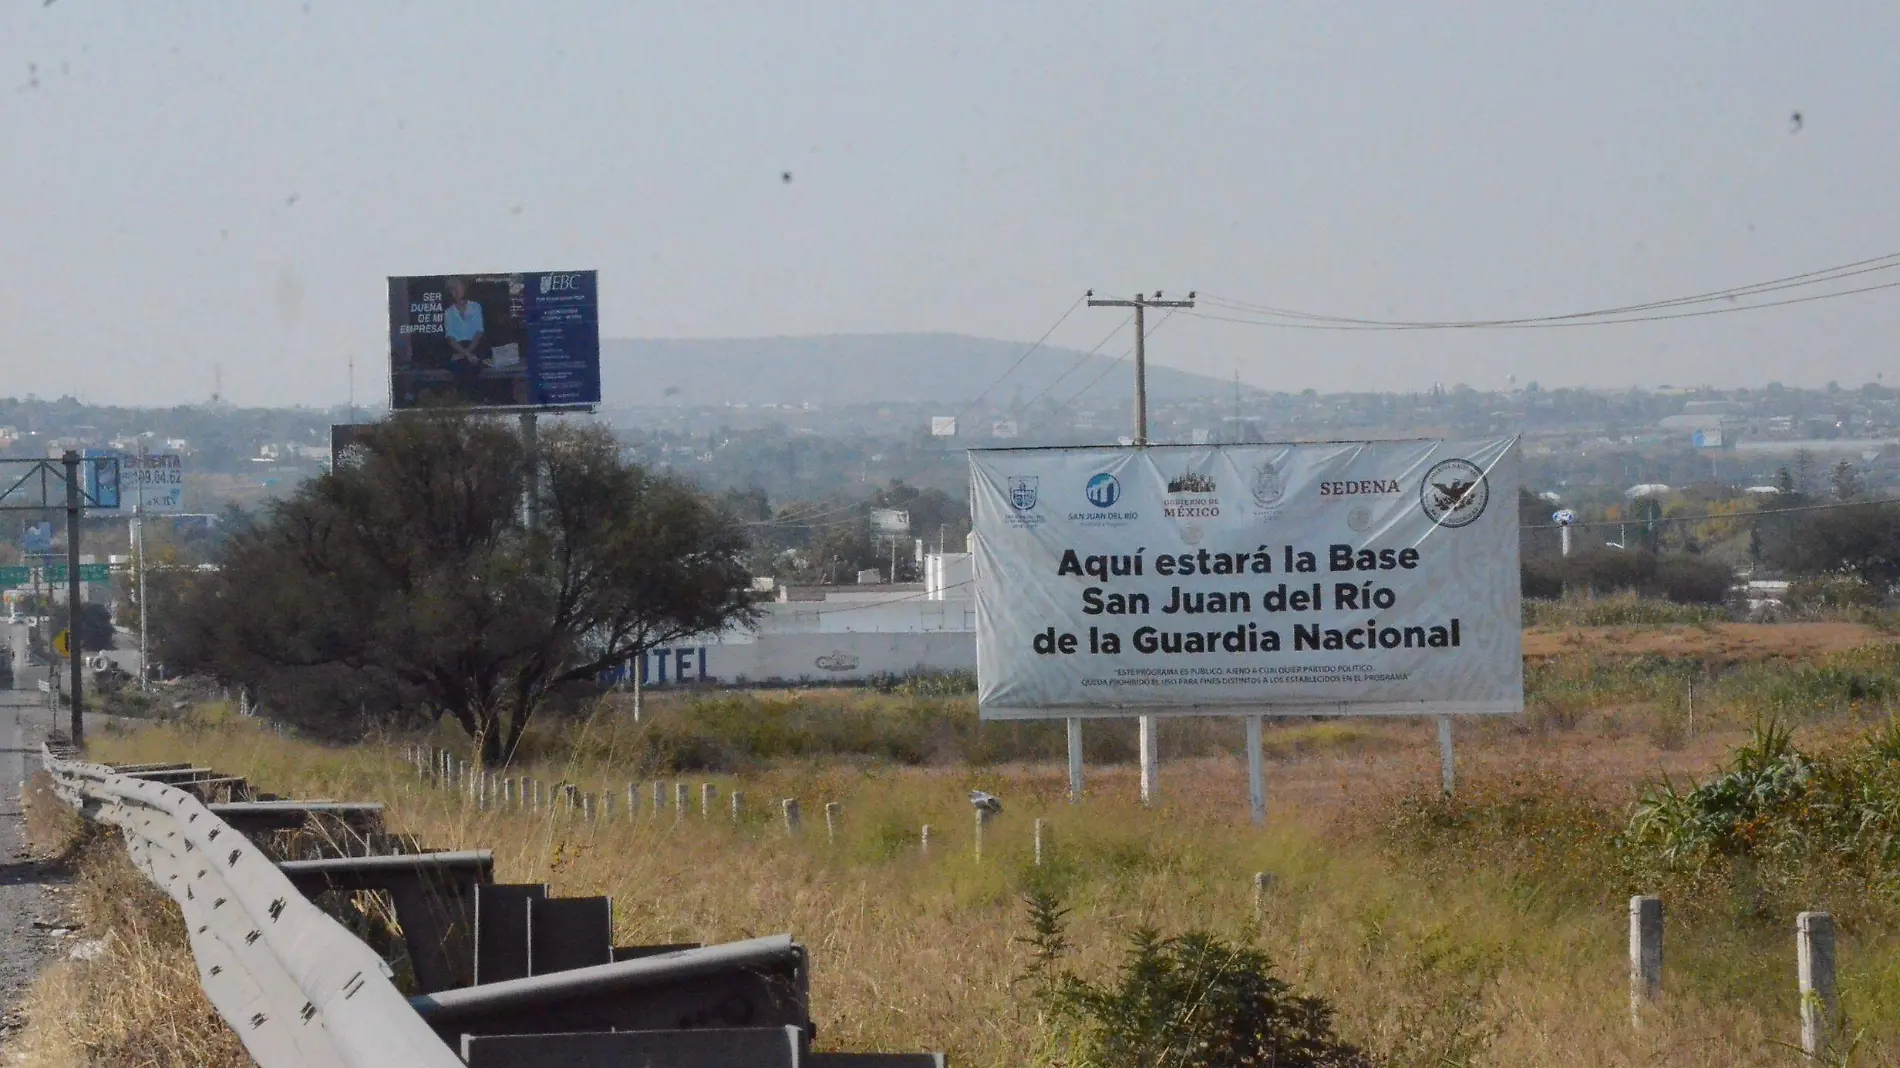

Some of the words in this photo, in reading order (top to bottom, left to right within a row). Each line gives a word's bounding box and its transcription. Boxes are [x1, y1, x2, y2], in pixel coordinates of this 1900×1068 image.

[552, 273, 580, 290] EBC
[422, 292, 442, 302] SER
[417, 313, 431, 323] DE
[432, 312, 443, 323] MI
[399, 324, 444, 335] EMPRESA
[1319, 480, 1401, 496] SEDENA
[1163, 499, 1206, 507] GOBIERNO
[1207, 498, 1220, 506] DE
[1068, 512, 1084, 520] SAN
[1086, 512, 1106, 520] JUAN
[1107, 511, 1122, 520] DEL
[1163, 506, 1220, 519] MÉXICO
[1058, 547, 1146, 582] Aquí
[1155, 545, 1271, 576] estará
[1283, 545, 1316, 573] la
[1329, 544, 1420, 572] Base
[1082, 587, 1149, 615] San
[1161, 586, 1251, 615] Juan
[1263, 583, 1322, 612] del
[1335, 580, 1396, 611] Río
[1033, 627, 1078, 655] de
[1090, 626, 1121, 654] la
[1132, 621, 1279, 654] Guardia
[1293, 618, 1461, 652] Nacional
[1136, 668, 1178, 677] PROGRAMA
[1180, 668, 1188, 676] ES
[1226, 667, 1251, 675] AJENO
[1259, 665, 1301, 675] CUALQUIER
[1302, 665, 1335, 675] PARTIDO
[1080, 679, 1107, 688] QUEDA
[1108, 678, 1150, 687] PROHIBIDO
[1151, 678, 1159, 686] EL
[1161, 677, 1177, 686] USO
[1178, 677, 1198, 686] PARA
[1199, 677, 1221, 685] FINES
[1222, 675, 1260, 685] DISTINTOS
[1269, 675, 1283, 684] LOS
[1285, 673, 1339, 684] ESTABLECIDOS
[1341, 673, 1352, 683] EN
[1353, 673, 1361, 682] EL
